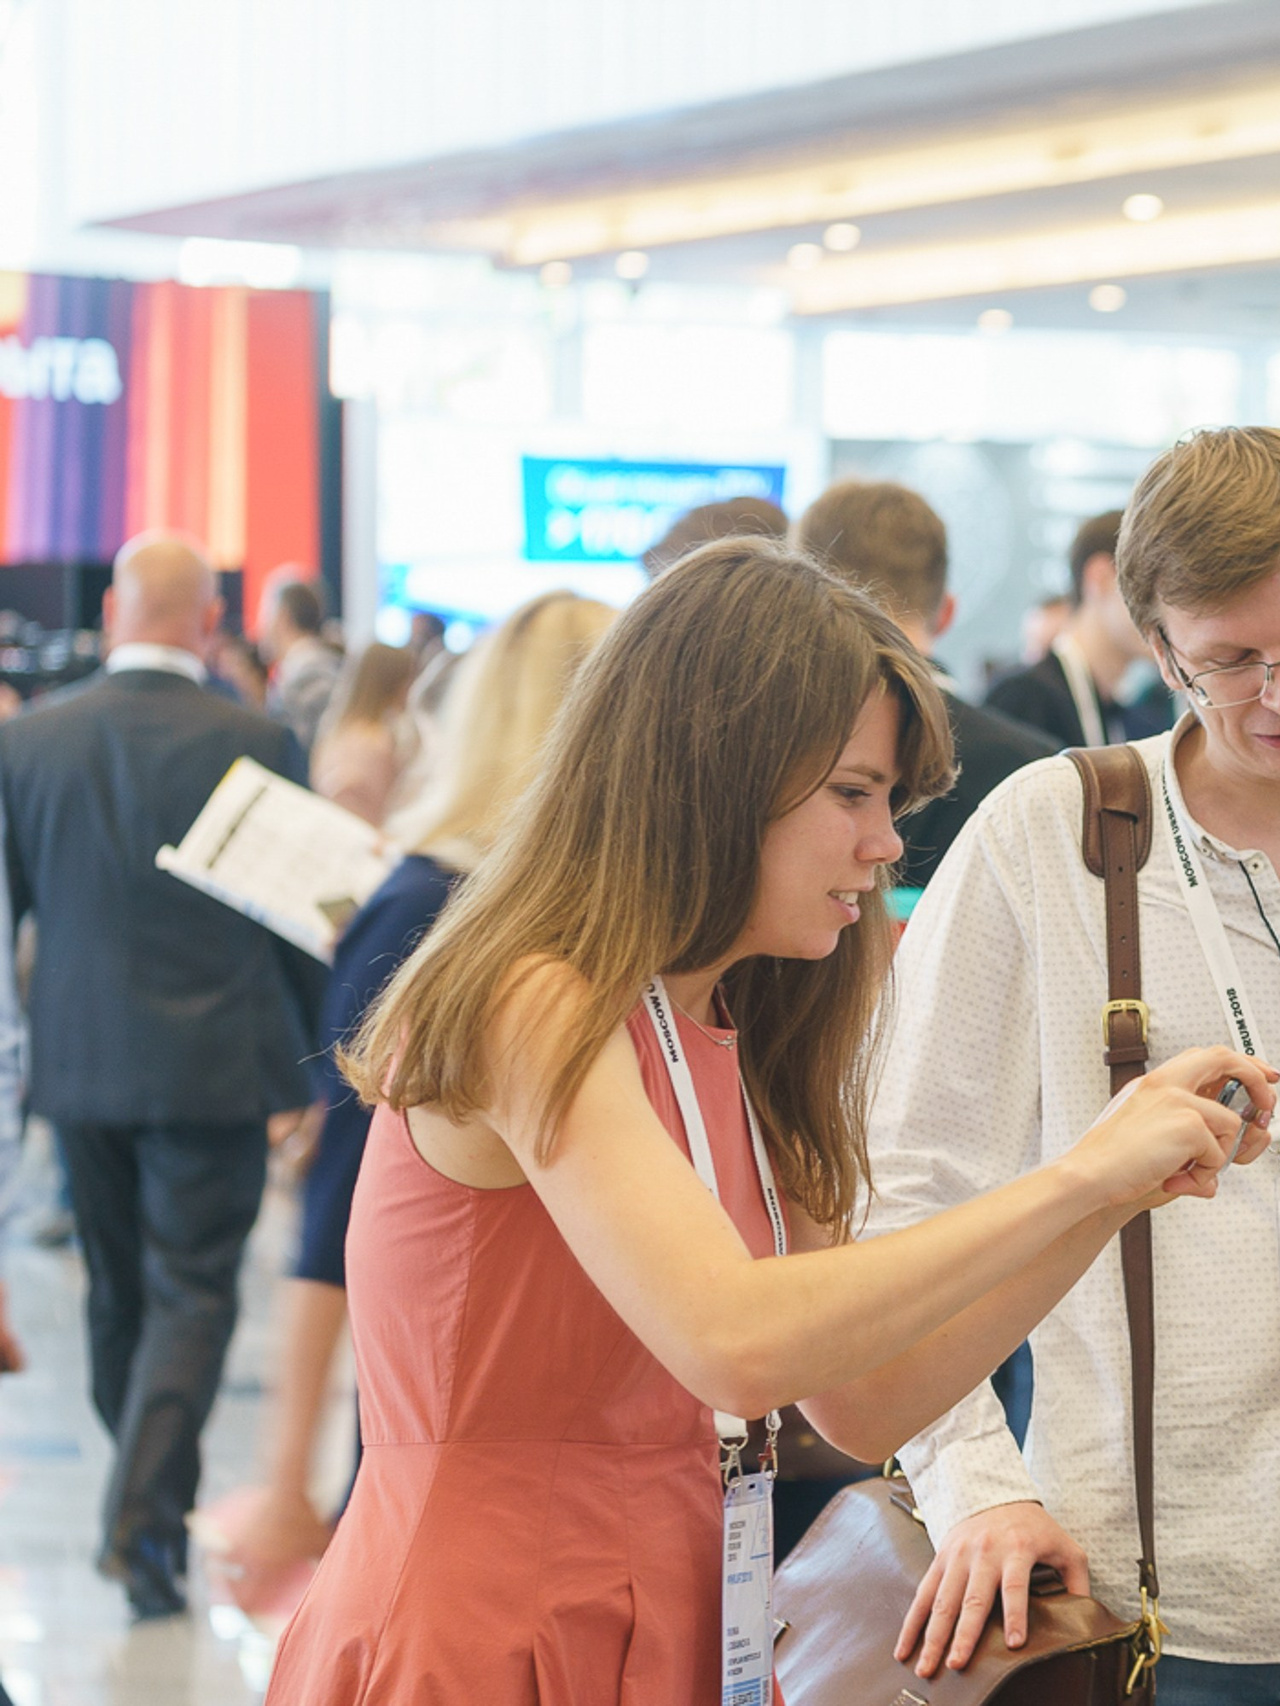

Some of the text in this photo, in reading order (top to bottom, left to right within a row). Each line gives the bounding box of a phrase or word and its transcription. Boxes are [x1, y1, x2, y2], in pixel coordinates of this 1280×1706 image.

[1164, 796, 1198, 888] MOSCOW URBAN
[649, 995, 679, 1063] MOSCOW
[1226, 988, 1255, 1056] ORUM 2018
